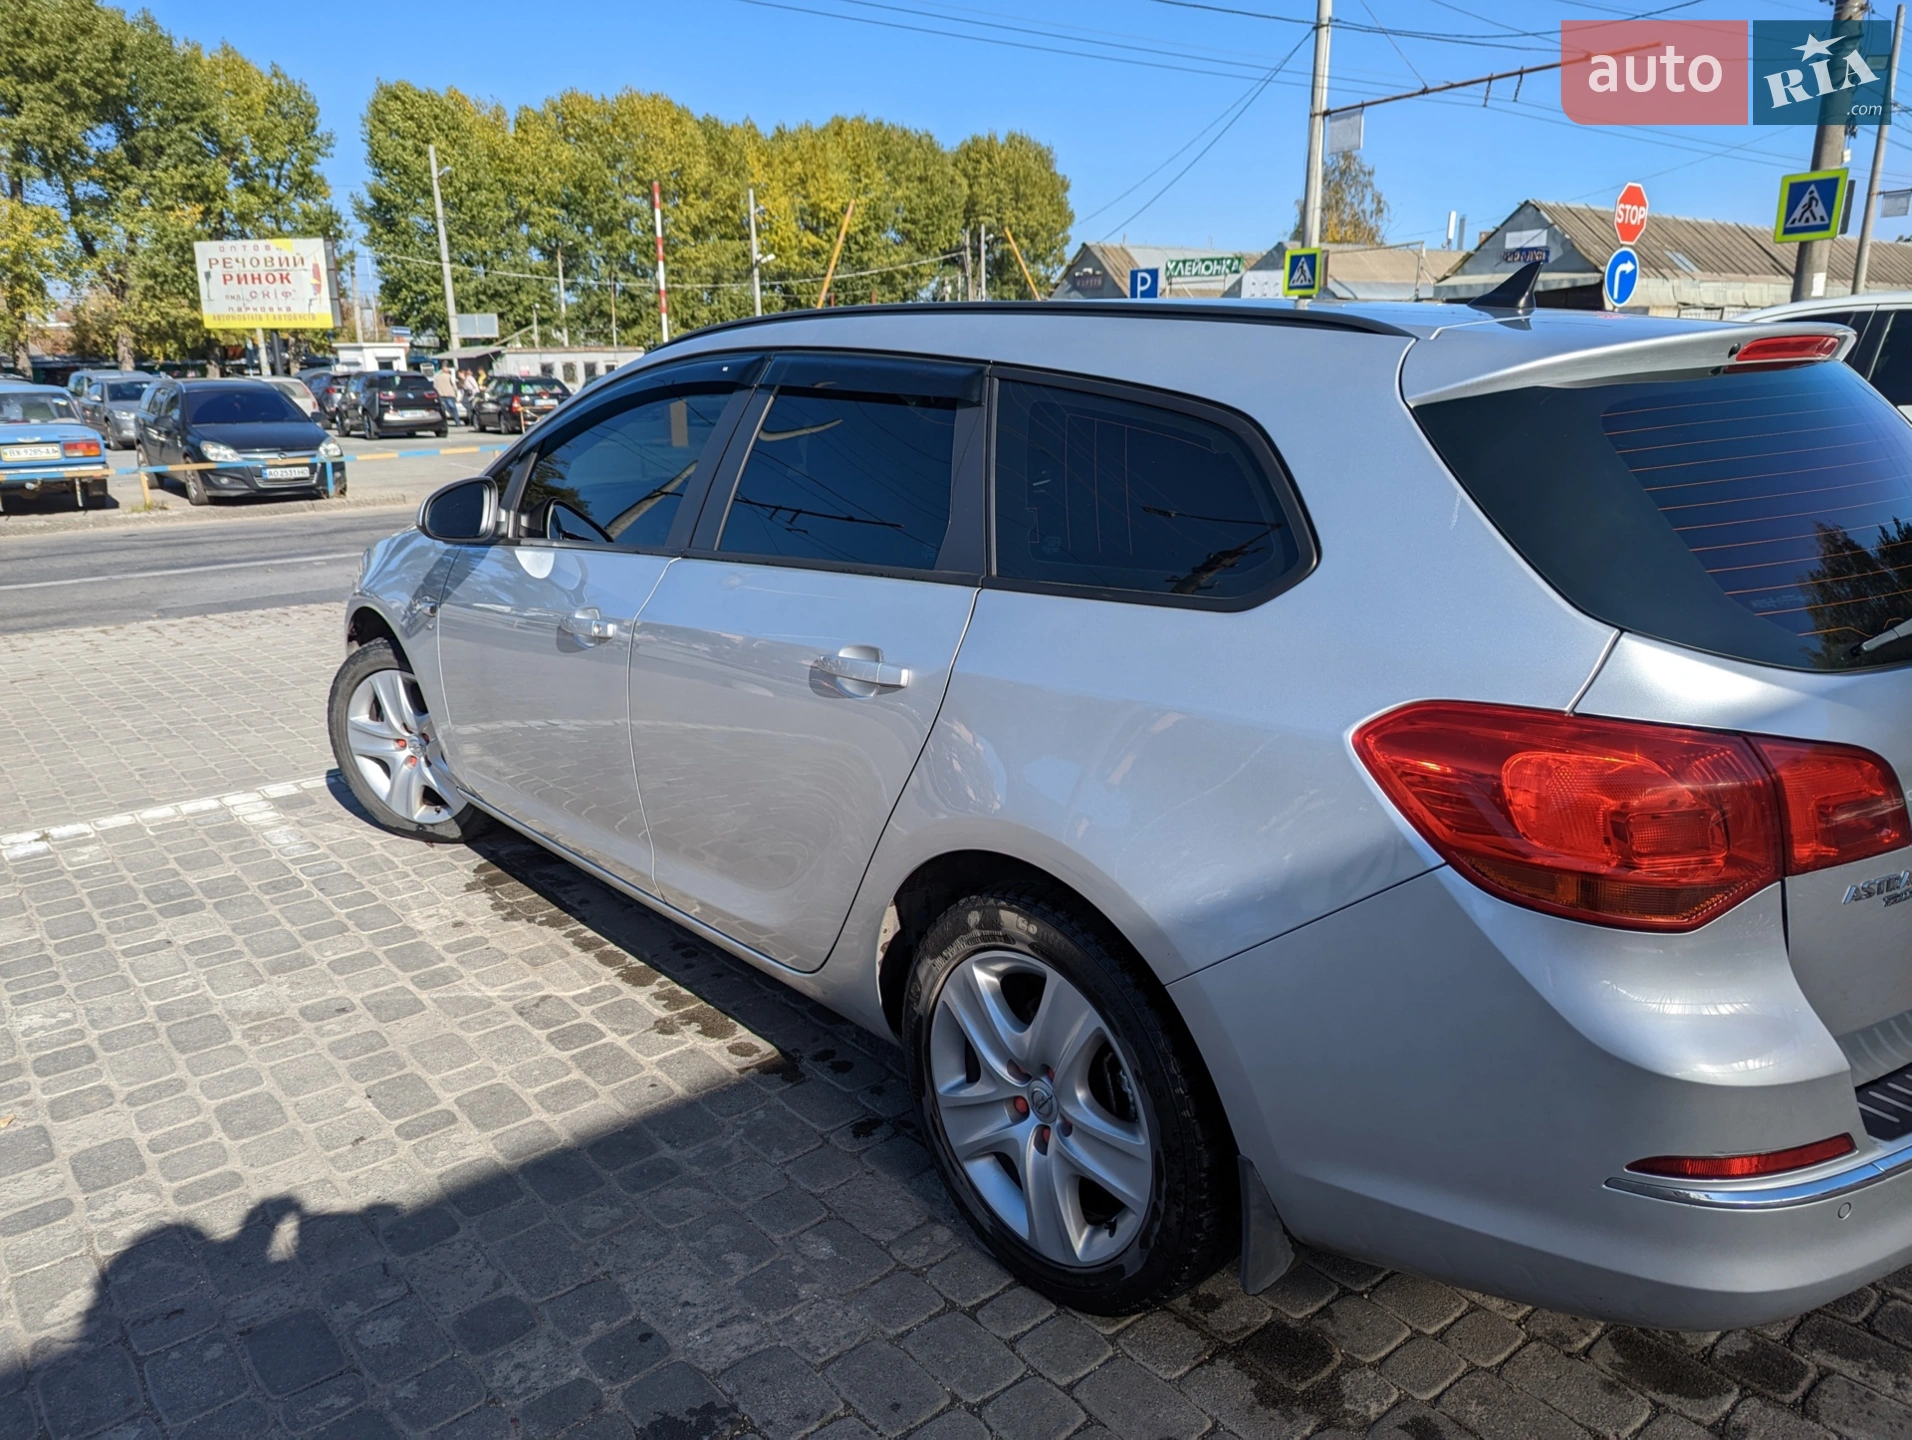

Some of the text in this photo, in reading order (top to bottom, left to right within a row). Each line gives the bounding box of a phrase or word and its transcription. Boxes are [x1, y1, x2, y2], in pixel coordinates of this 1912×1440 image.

[1616, 203, 1646, 225] STOP
[208, 252, 305, 269] РЕЧОВИЙ
[222, 272, 292, 285] РИНОК
[1137, 271, 1152, 298] P
